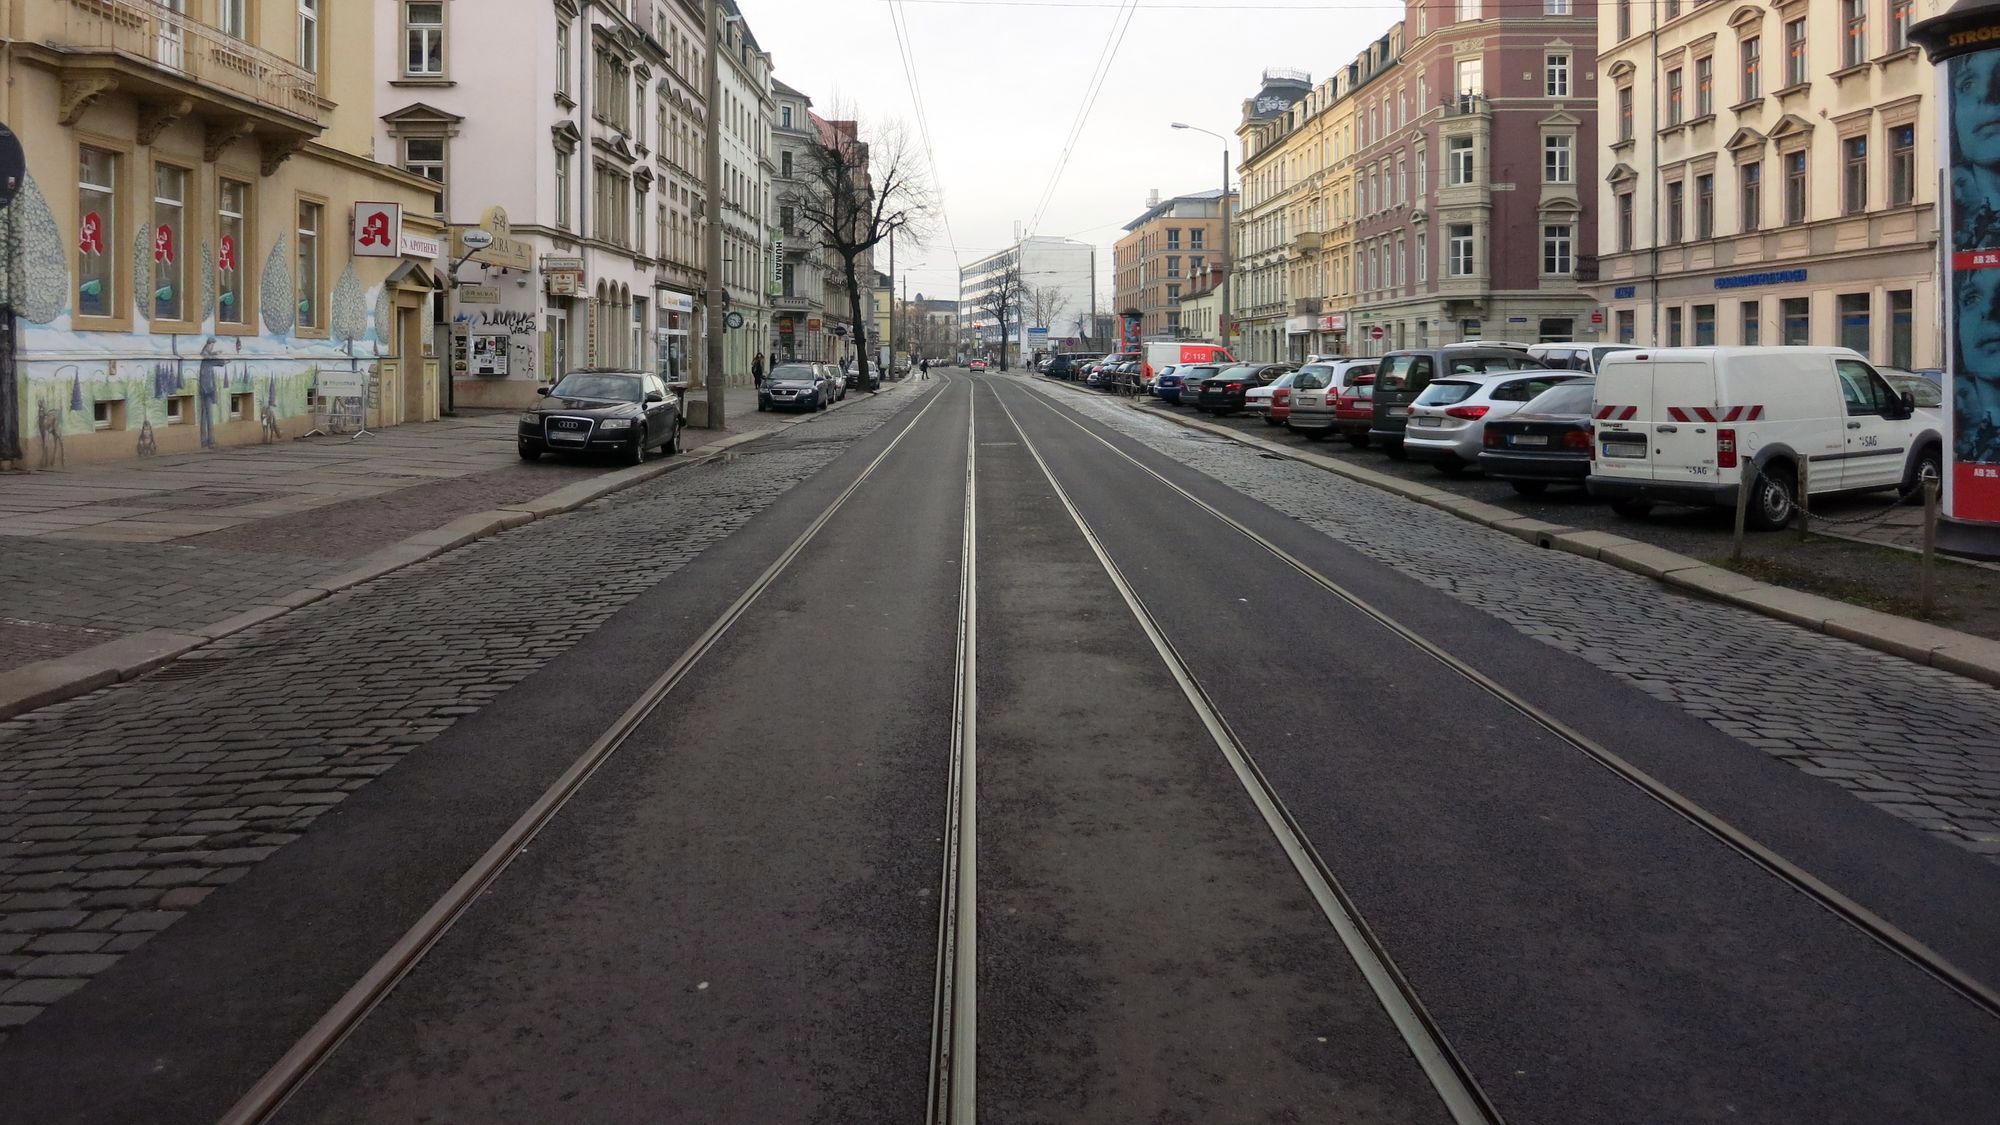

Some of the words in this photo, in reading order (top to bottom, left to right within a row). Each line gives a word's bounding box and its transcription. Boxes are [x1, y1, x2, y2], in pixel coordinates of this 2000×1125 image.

[410, 240, 438, 255] APOTHEKE
[1865, 435, 1877, 447] SAG
[1692, 466, 1707, 475] SAG
